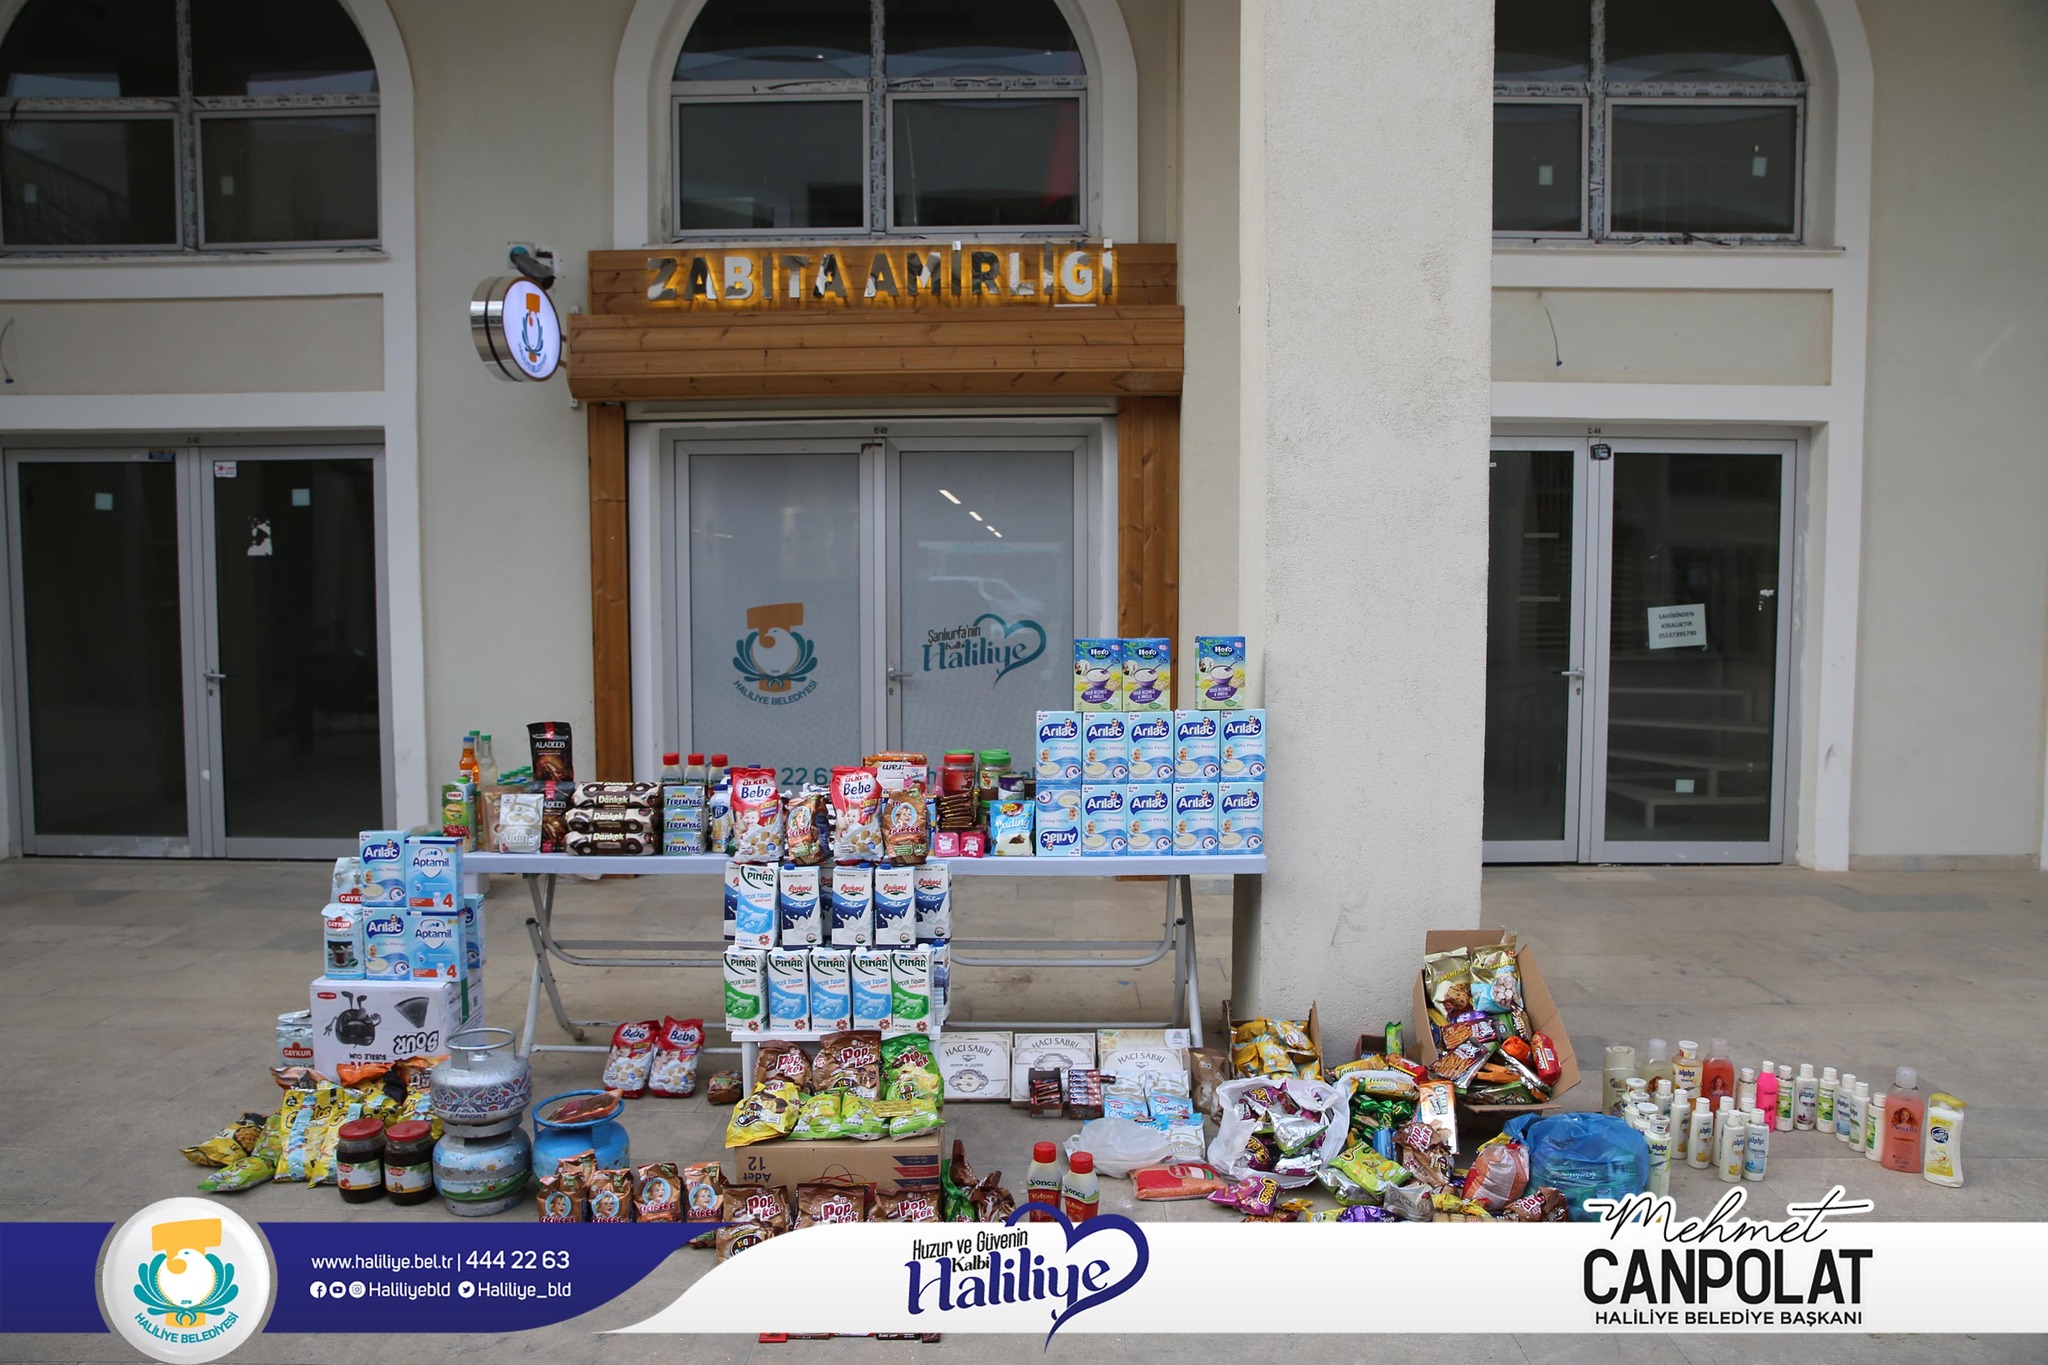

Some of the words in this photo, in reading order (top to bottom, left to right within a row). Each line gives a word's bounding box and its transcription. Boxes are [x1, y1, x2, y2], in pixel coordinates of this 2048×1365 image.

[647, 253, 847, 300] ZABITA
[863, 239, 1114, 298] AMİRLİĞİ
[922, 637, 1027, 672] Haliliye
[733, 680, 770, 705] HALİLİYE
[742, 778, 769, 787] ÜLKER
[741, 786, 772, 799] Bebe
[843, 782, 872, 796] Bebe
[593, 812, 625, 822] Dankek
[592, 832, 625, 842] Dankek
[413, 857, 450, 868] Aptamil
[442, 894, 454, 908] 4
[415, 929, 452, 939] Aptamil
[731, 957, 757, 968] PINAR
[775, 957, 803, 968] PINAR
[817, 957, 845, 968] PINAR
[860, 957, 888, 968] PINAR
[899, 956, 927, 967] PINAR
[446, 964, 457, 978] 4
[622, 1028, 646, 1039] Bebe
[669, 1030, 696, 1042] Bebe
[393, 1030, 440, 1055] SOUR
[1032, 1038, 1052, 1049] HACI
[841, 1047, 869, 1063] Pop
[945, 1046, 966, 1057] HACI
[968, 1044, 993, 1056] SABRİ
[778, 1054, 801, 1070] Pop
[1118, 1053, 1139, 1064] HACI
[1140, 1052, 1166, 1063] SABRİ
[747, 1156, 766, 1171] 12
[743, 1172, 772, 1183] Adet
[748, 1195, 774, 1213] Pop
[899, 1199, 927, 1215] Pop
[823, 1203, 852, 1220] Pop
